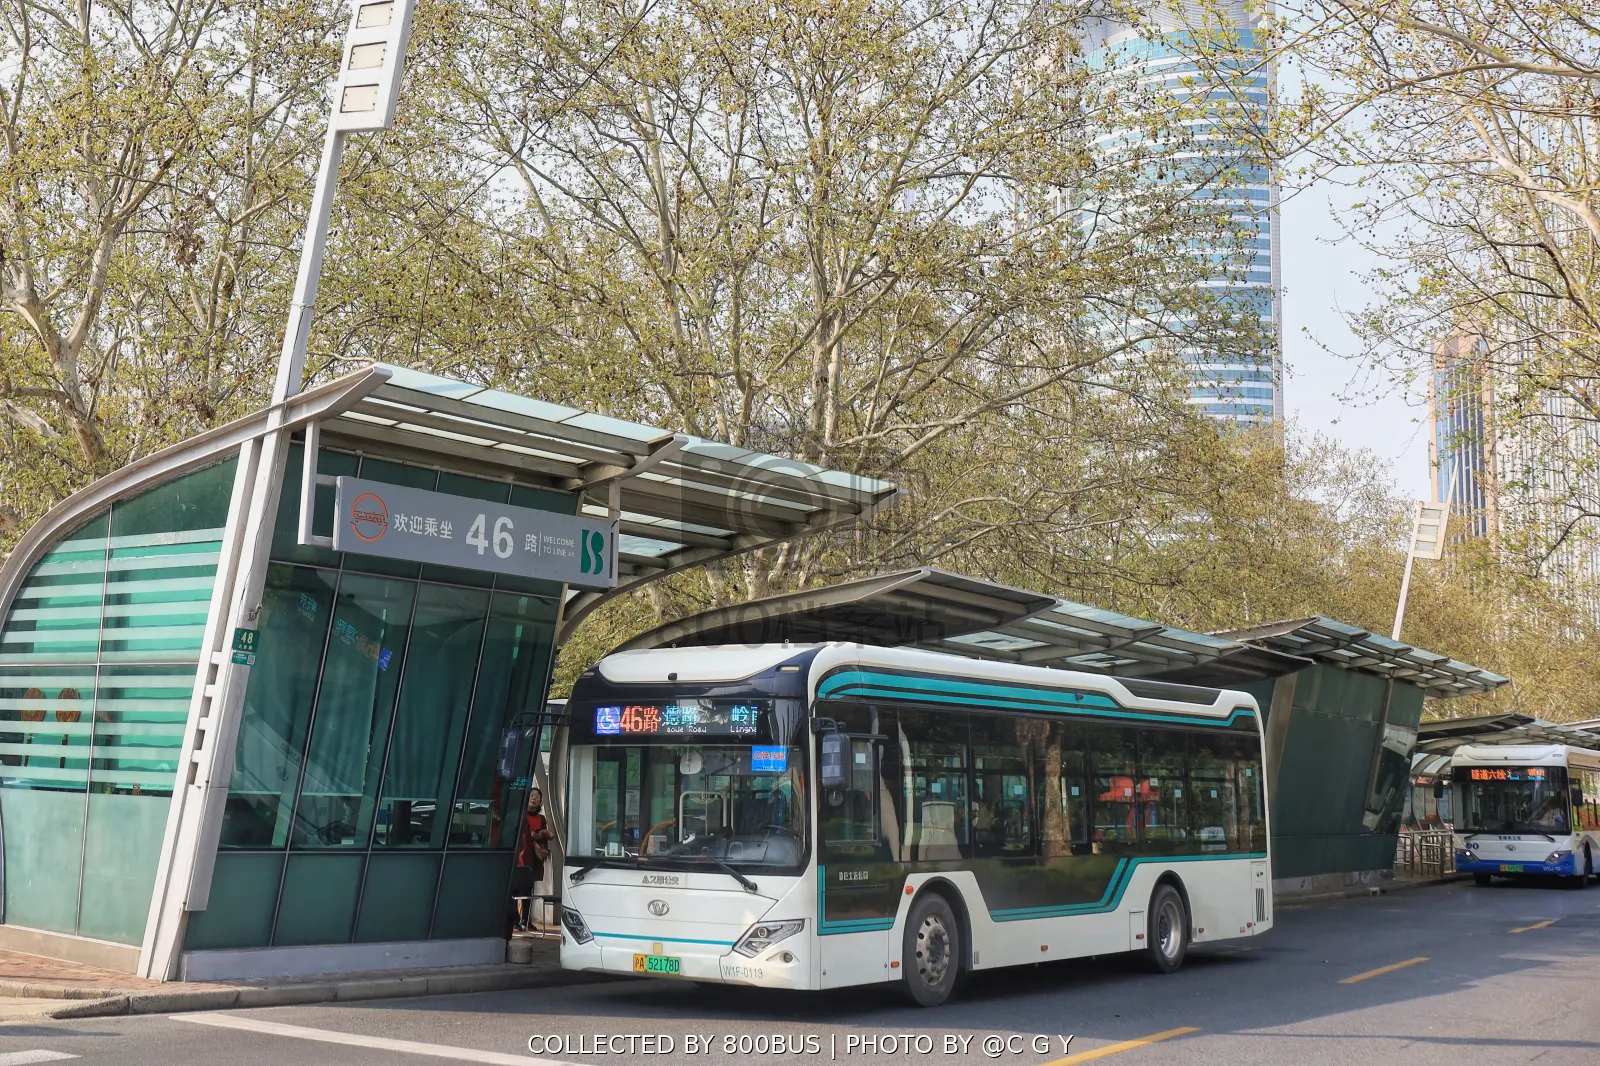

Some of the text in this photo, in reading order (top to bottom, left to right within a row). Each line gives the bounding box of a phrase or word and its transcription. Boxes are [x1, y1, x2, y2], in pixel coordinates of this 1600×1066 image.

[394, 513, 453, 539] 欢迎乘坐
[465, 513, 514, 559] 46
[525, 533, 538, 553] 路
[543, 535, 574, 548] WELCOME
[543, 546, 552, 554] TO
[553, 547, 566, 557] LINE
[241, 632, 254, 644] 48
[620, 706, 659, 732] 46路
[1471, 769, 1506, 780] 隧道六线
[722, 965, 763, 979] W1F-0119
